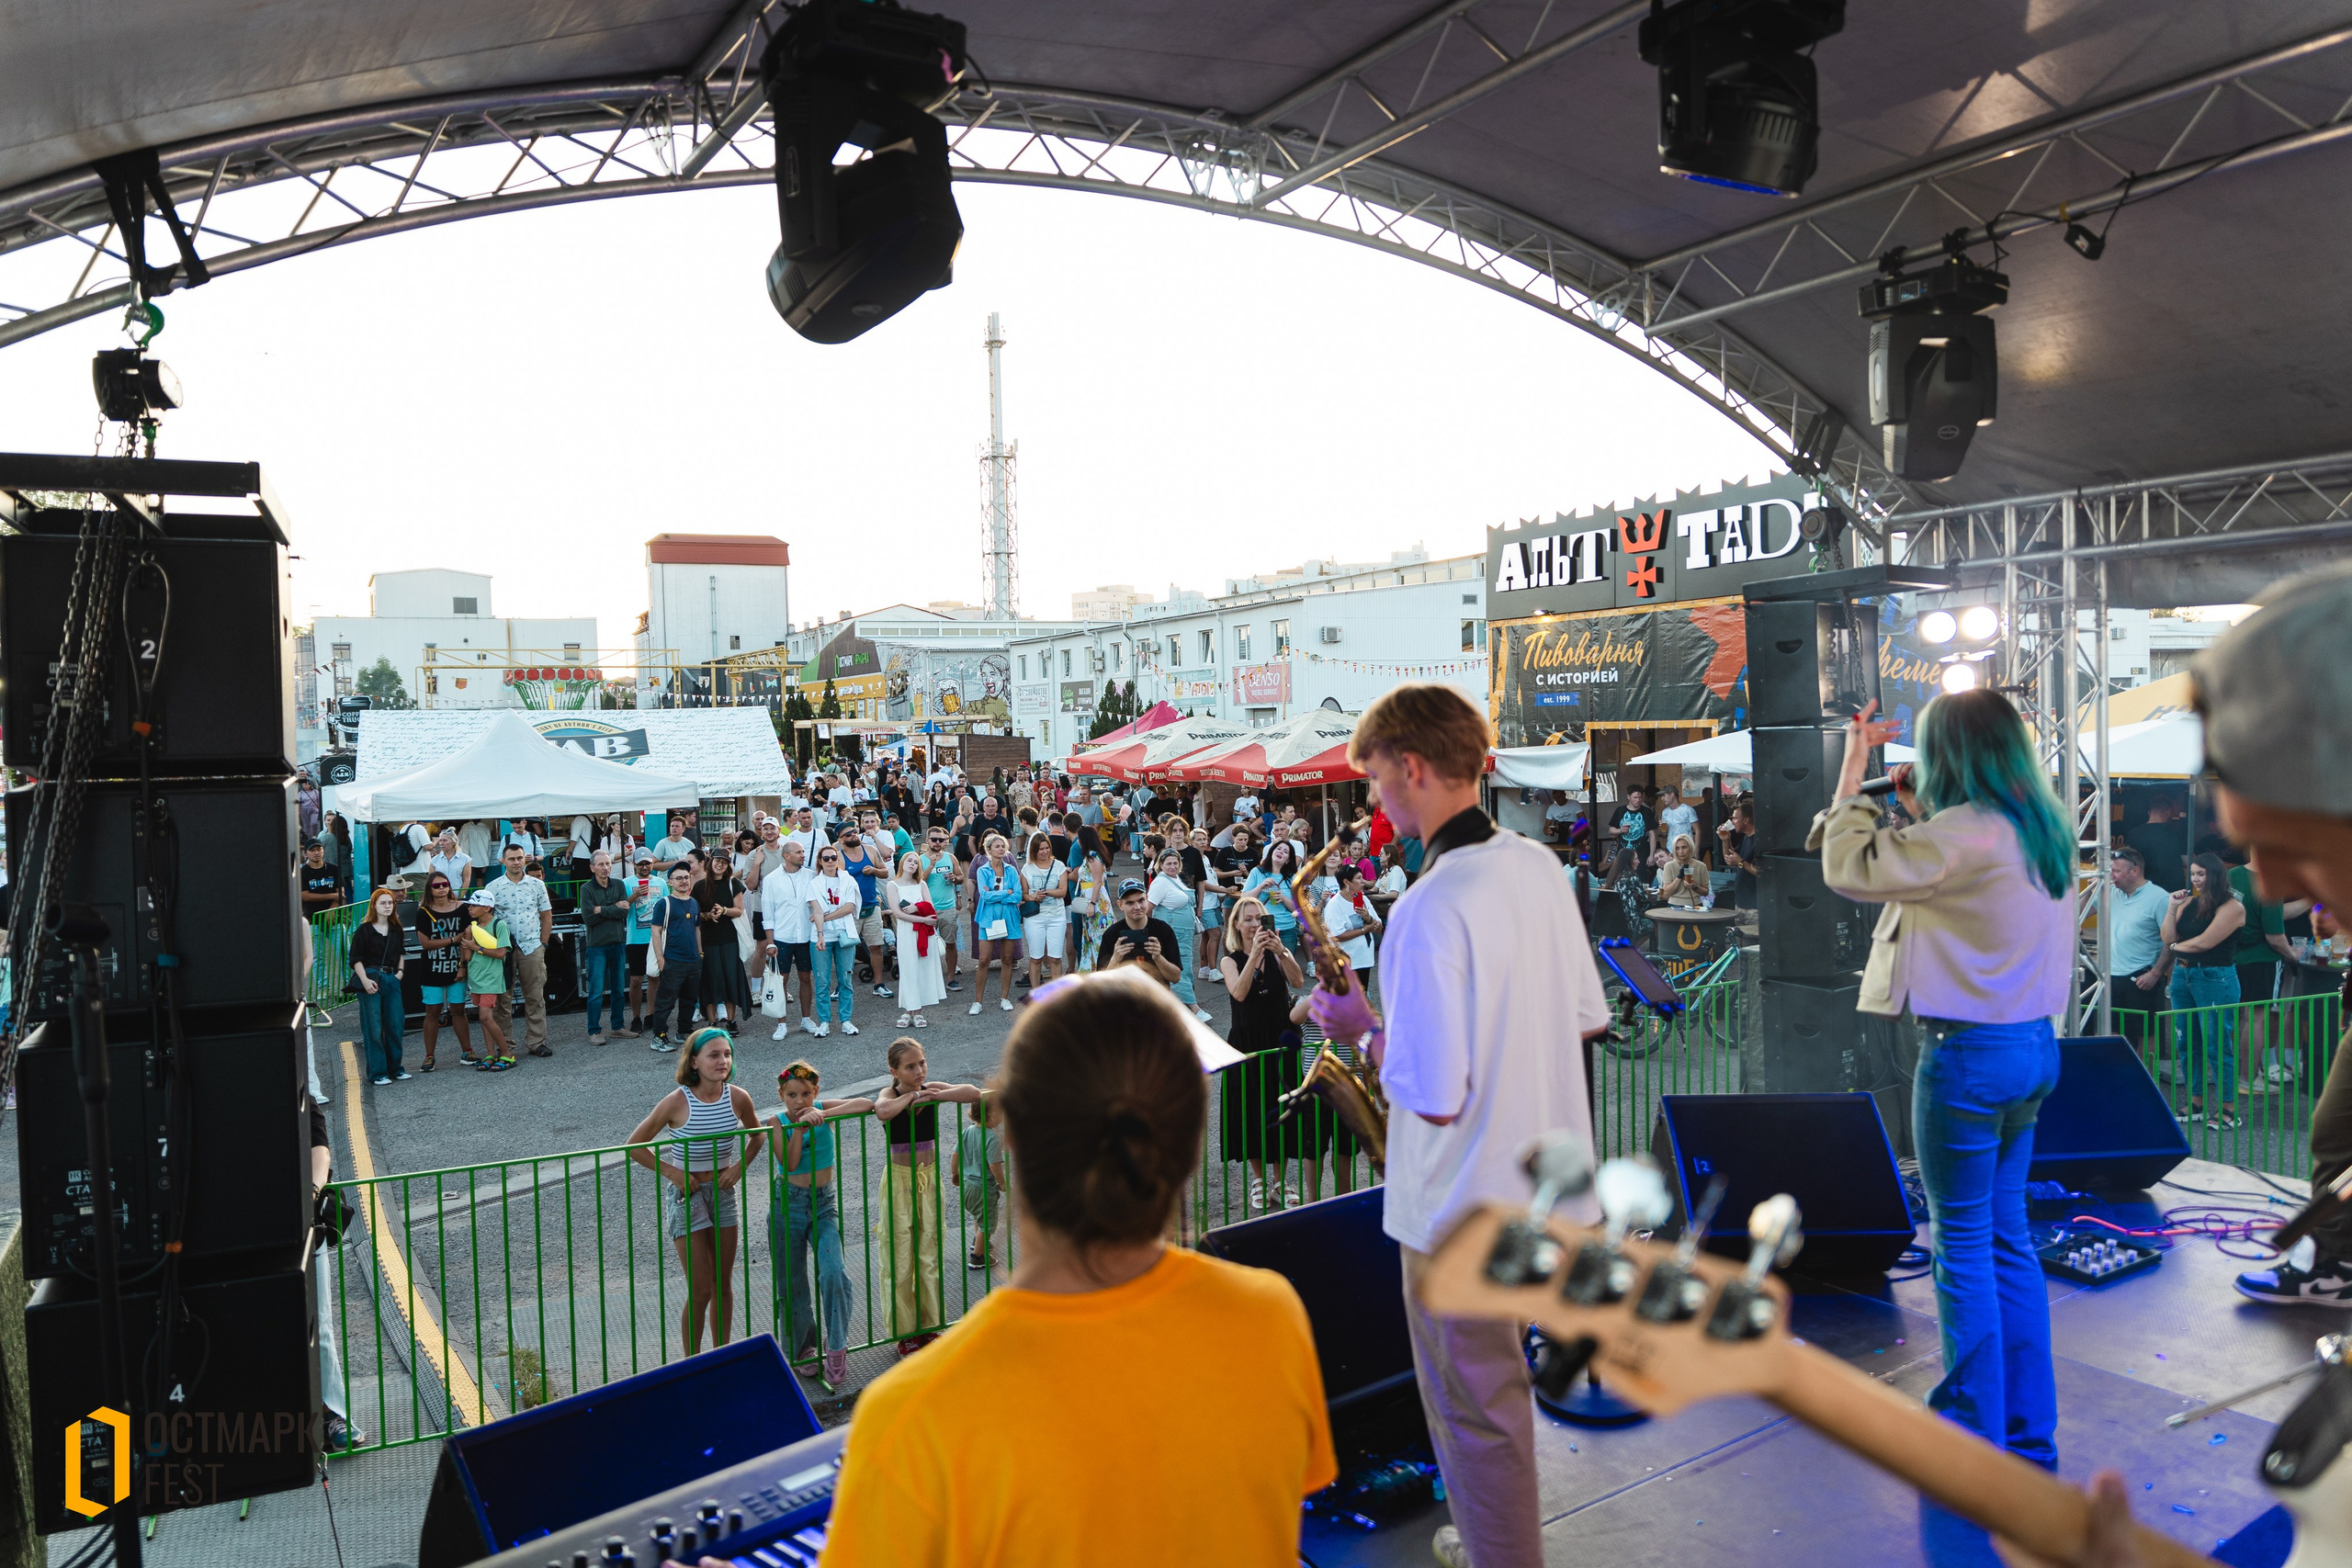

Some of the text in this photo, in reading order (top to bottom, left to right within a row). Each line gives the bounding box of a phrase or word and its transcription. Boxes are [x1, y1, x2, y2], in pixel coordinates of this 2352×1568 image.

[141, 639, 155, 659] 2
[1523, 630, 1645, 671] Пивоварня
[1250, 672, 1280, 687] DENSO
[1547, 668, 1619, 685] ИСТОРИЕЙ
[1544, 694, 1570, 704] est. 1999
[1315, 729, 1354, 739] PRIM
[551, 736, 632, 757] AB
[1148, 771, 1167, 782] PRIM
[1243, 770, 1265, 783] PRIMATOR
[1282, 770, 1324, 784] PRIMATOR
[552, 855, 572, 868] FA
[427, 947, 447, 959] WE
[432, 960, 458, 973] HER
[157, 1137, 168, 1157] 7
[169, 1383, 185, 1403] 4
